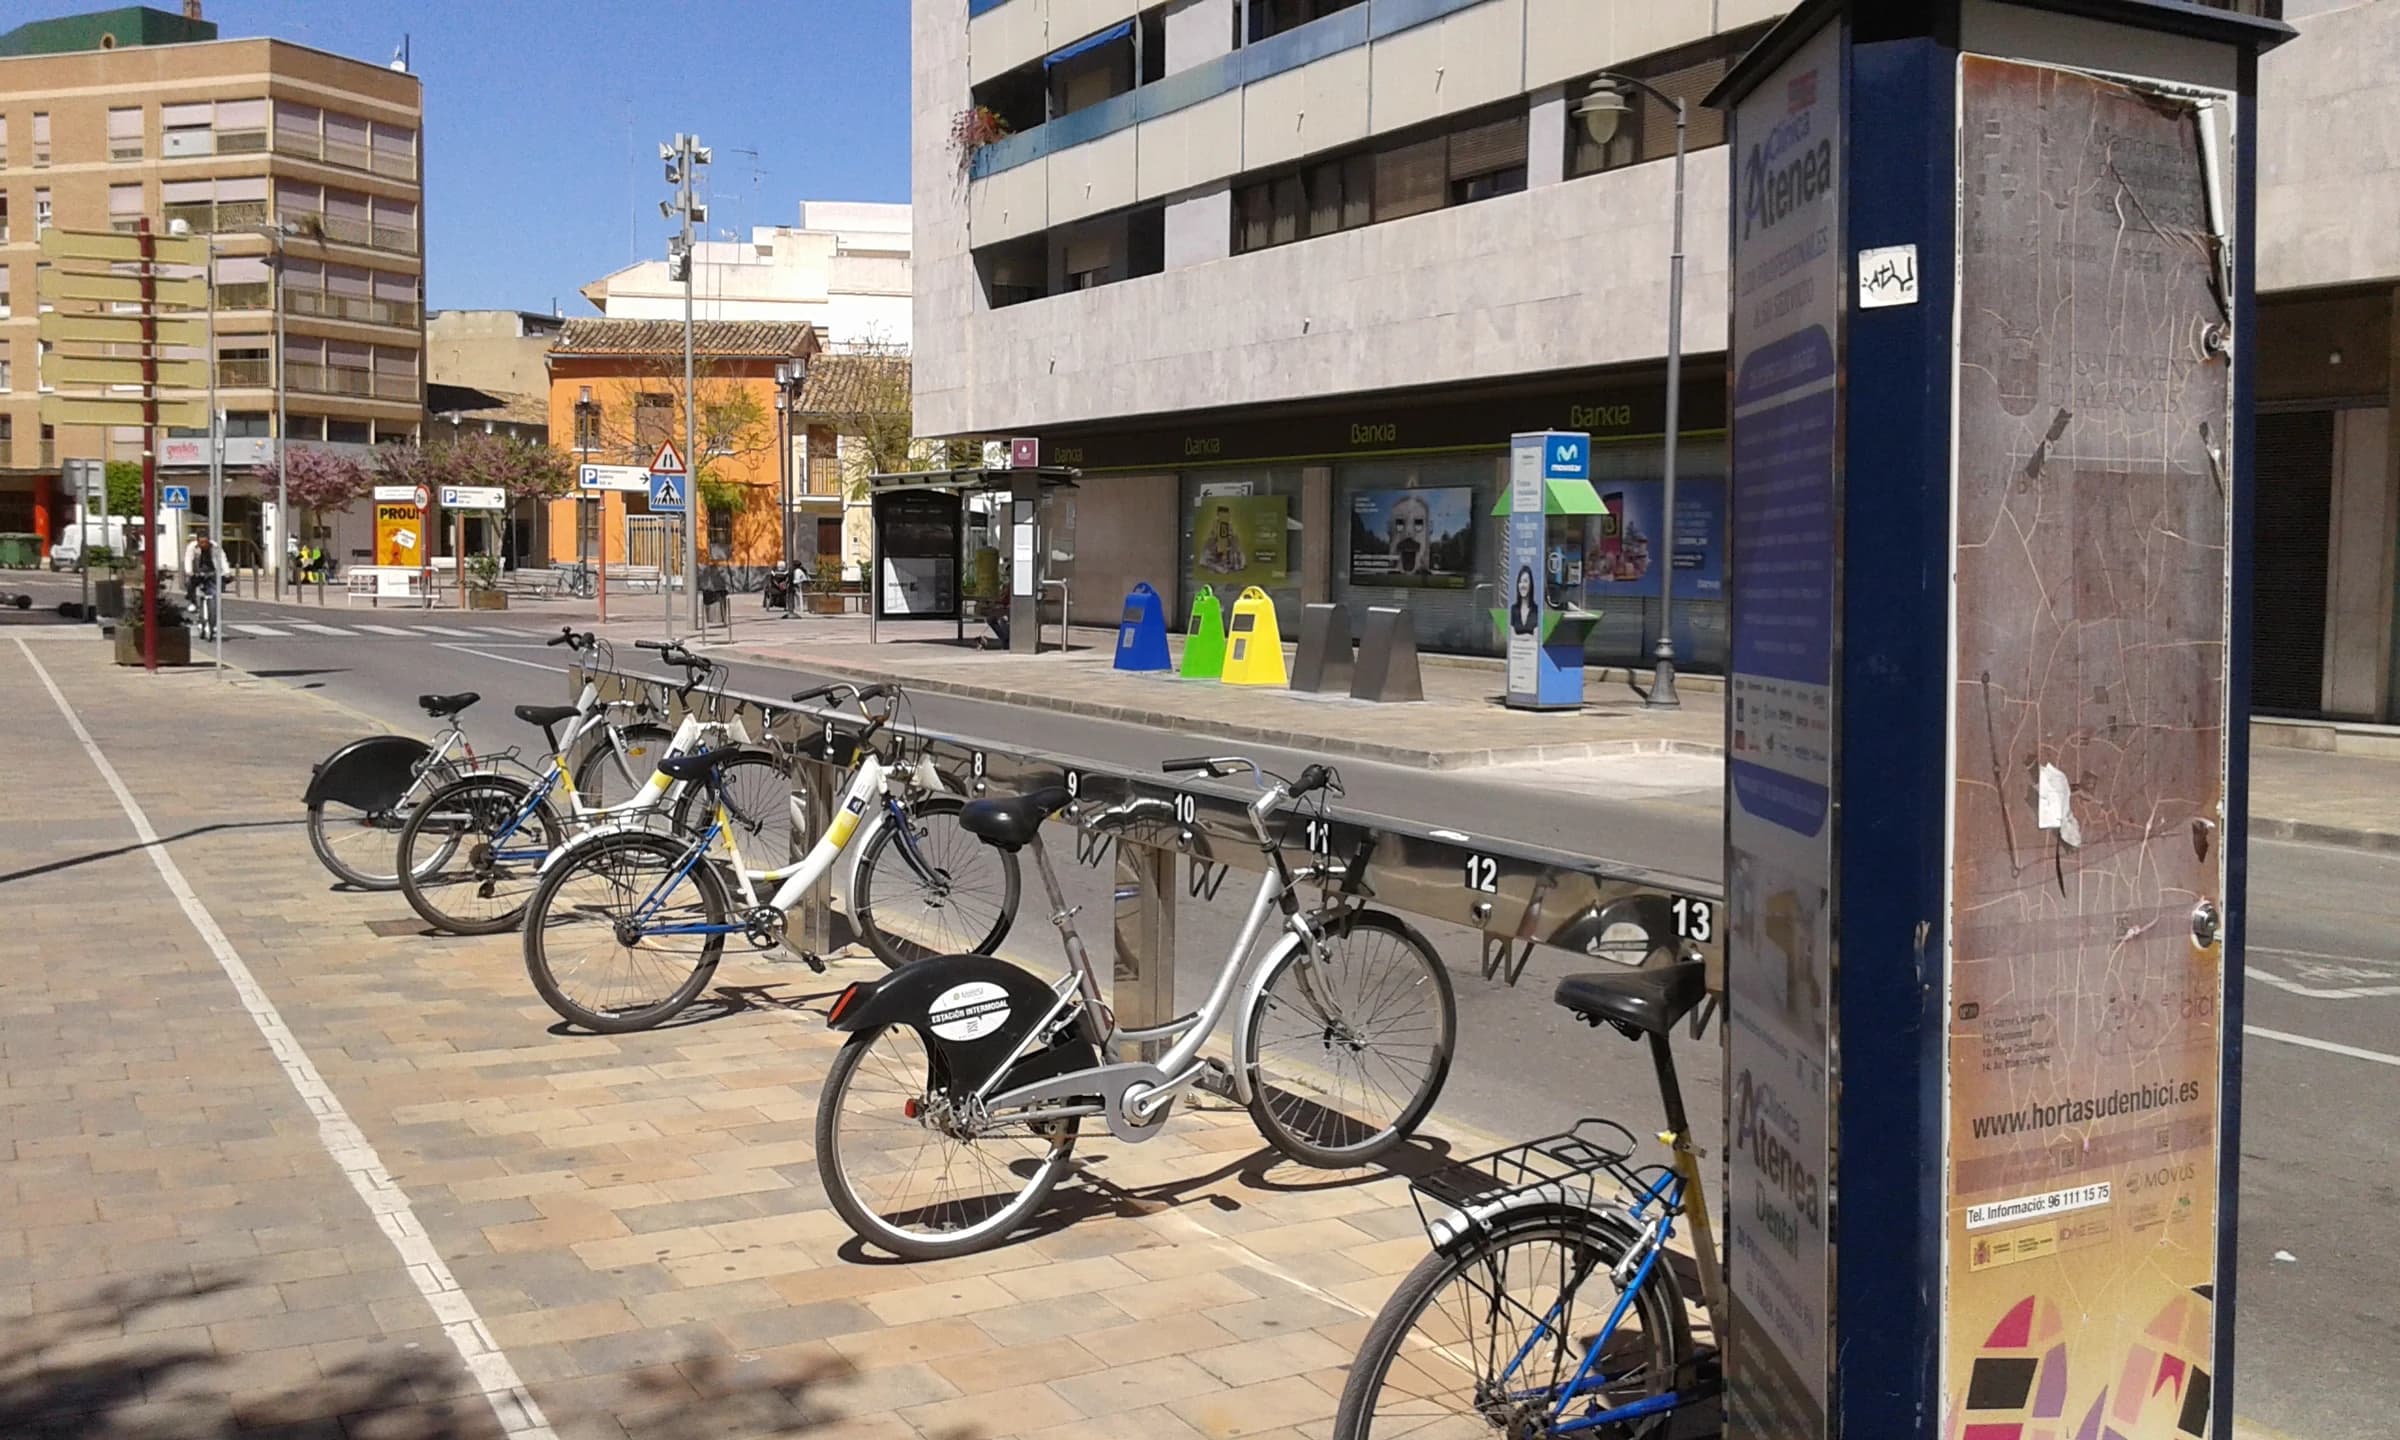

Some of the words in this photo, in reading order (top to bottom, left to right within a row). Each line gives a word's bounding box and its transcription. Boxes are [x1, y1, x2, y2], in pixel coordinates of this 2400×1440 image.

[1744, 137, 1831, 240] Atenea
[1571, 404, 1631, 428] Bankia
[1350, 422, 1396, 444] Bankia
[1184, 436, 1220, 456] Bankia
[584, 469, 596, 484] P
[445, 489, 456, 504] P
[763, 707, 771, 728] 5
[824, 726, 833, 744] 6
[974, 751, 983, 776] 8
[1066, 771, 1078, 797] 9
[1174, 793, 1196, 823] 10
[1305, 820, 1329, 854] 11
[1466, 853, 1498, 894] 12
[1672, 897, 1712, 942] 13
[965, 1000, 1009, 1017] INTERMODAL
[1972, 1079, 2200, 1139] www.hortasudenbici.es
[1736, 1067, 1819, 1231] Atenea
[2144, 1162, 2195, 1187] MOVUS
[1968, 1208, 1985, 1224] Tel.
[1987, 1197, 2046, 1220] Informació:
[2047, 1194, 2061, 1209] 96
[2063, 1189, 2080, 1206] 111
[2083, 1187, 2095, 1201] 15
[2097, 1184, 2109, 1199] 75
[1755, 1179, 1799, 1263] Dental
